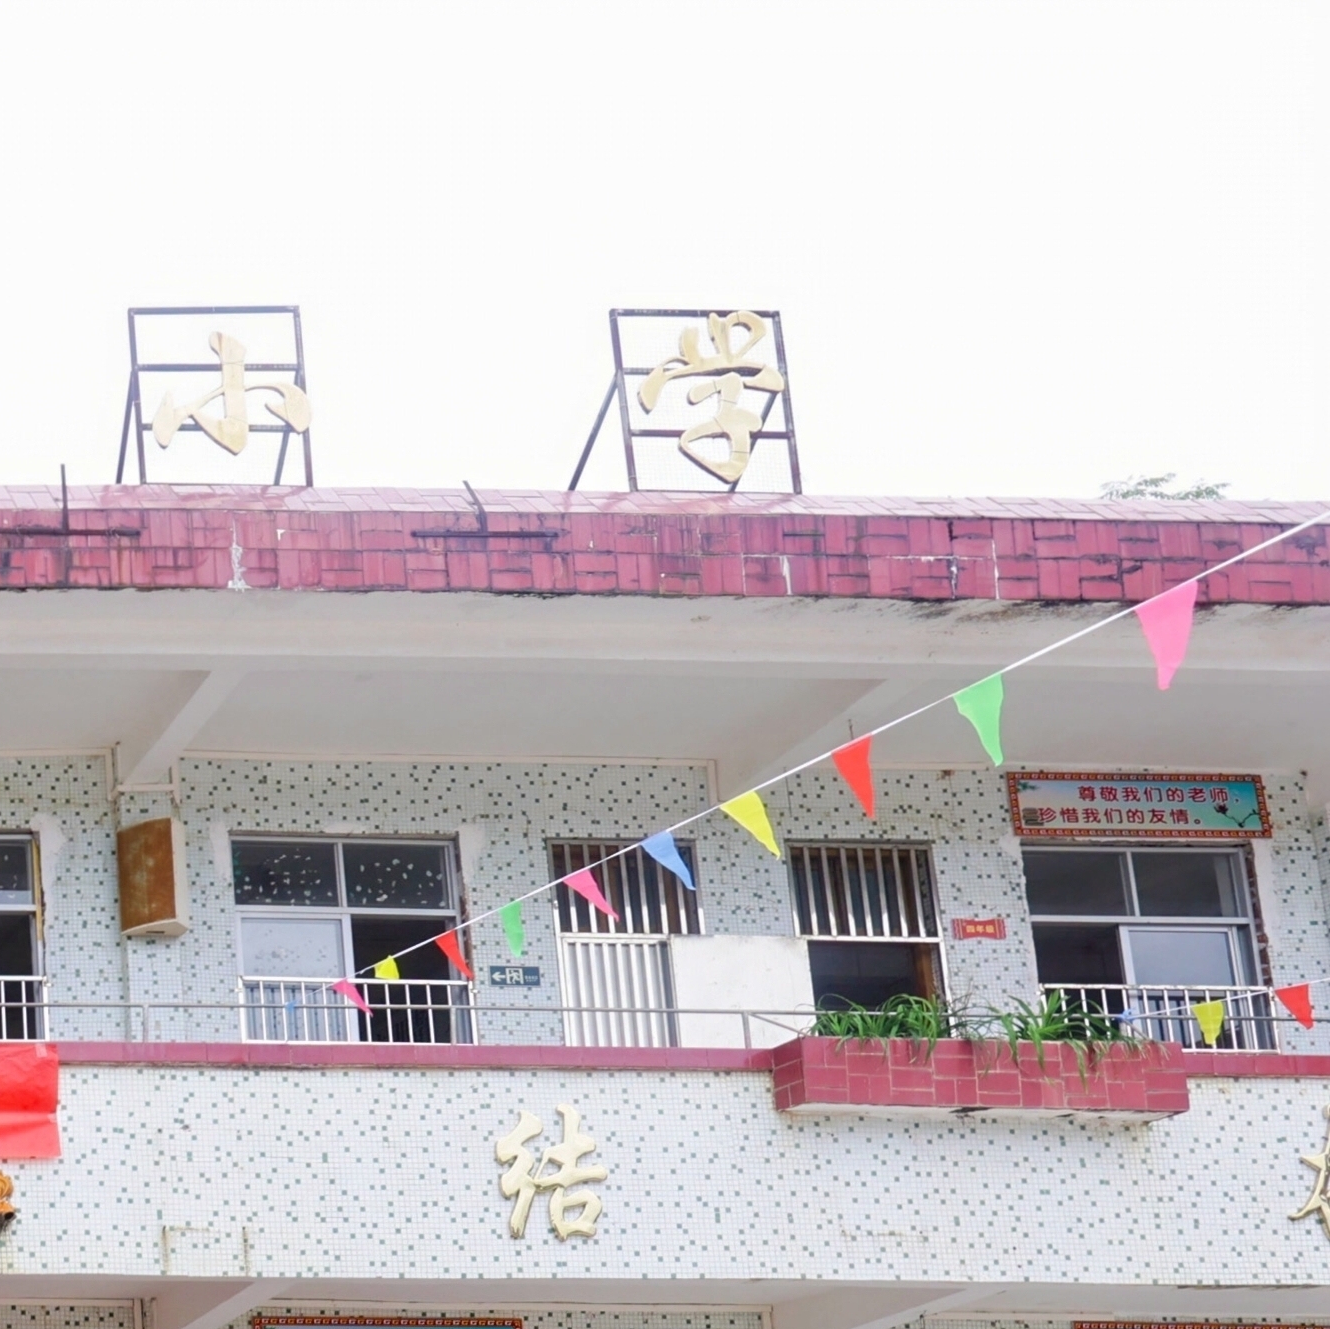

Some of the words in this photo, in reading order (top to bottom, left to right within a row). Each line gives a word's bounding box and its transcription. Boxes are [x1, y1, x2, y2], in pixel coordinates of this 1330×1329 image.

[1038, 807, 1202, 827] 珍惜我们的友情。
[965, 924, 995, 934] 四年级
[495, 1104, 608, 1242] 结
